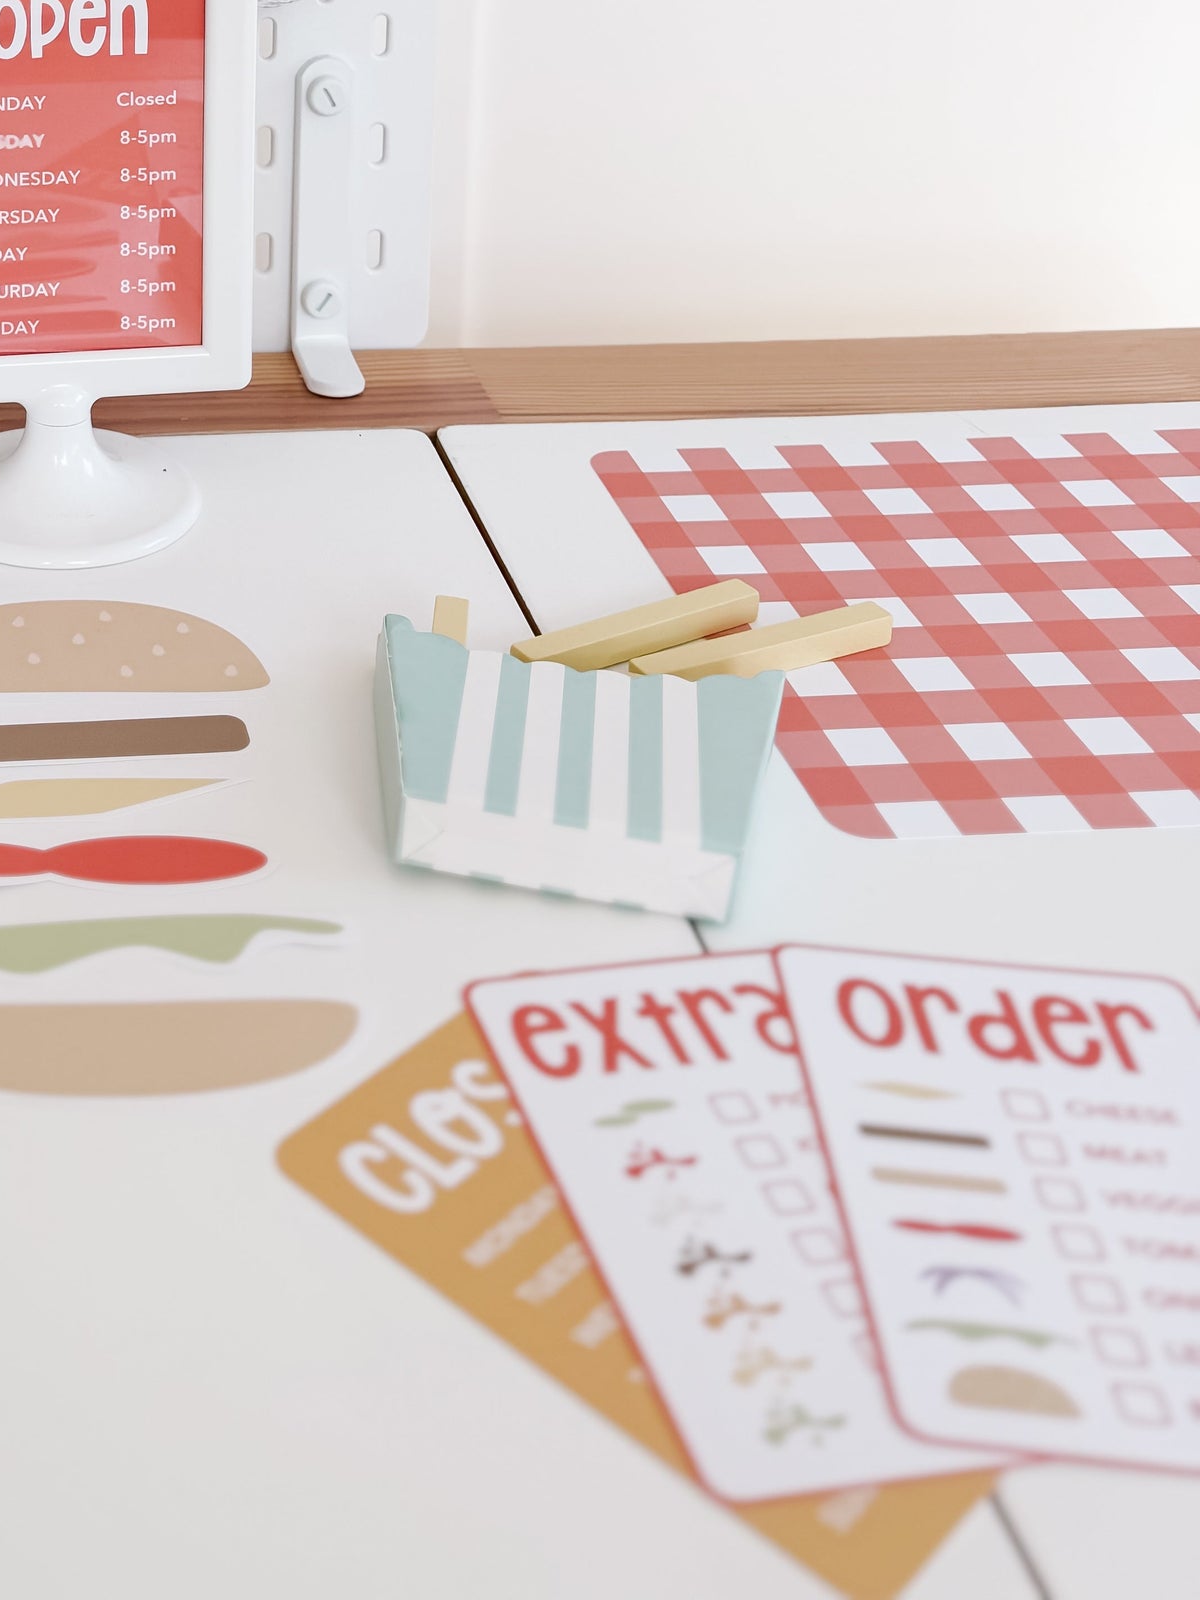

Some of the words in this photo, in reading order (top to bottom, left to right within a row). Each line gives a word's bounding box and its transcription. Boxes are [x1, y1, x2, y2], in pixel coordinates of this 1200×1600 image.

[115, 89, 177, 108] Closed
[119, 129, 177, 149] 8-5pm
[119, 167, 177, 185] 8-5pm
[119, 204, 177, 225] 8-5pm
[119, 240, 176, 262] 8-5pm
[118, 276, 176, 298] 8-5pm
[119, 313, 176, 335] 8-5pm
